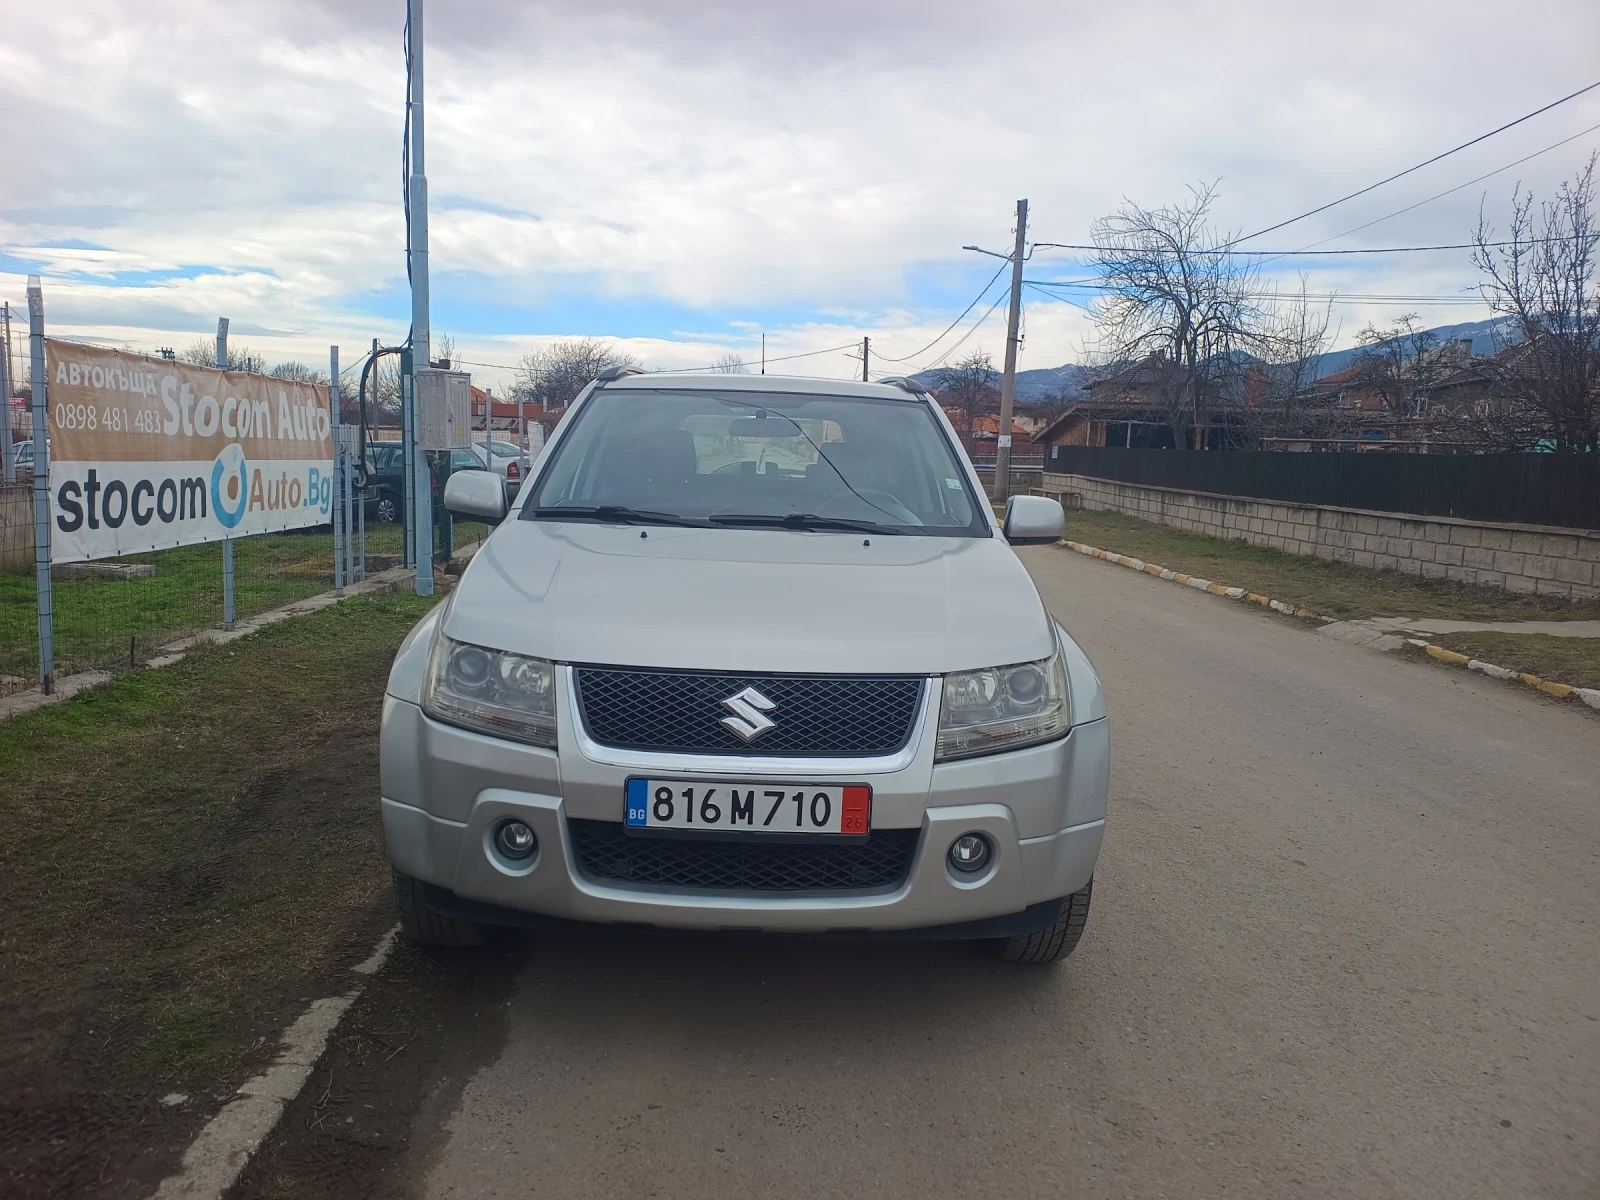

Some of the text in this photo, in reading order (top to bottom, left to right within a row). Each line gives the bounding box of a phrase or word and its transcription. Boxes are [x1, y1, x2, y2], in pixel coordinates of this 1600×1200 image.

[56, 361, 157, 398] АВТОКЪЩА
[55, 402, 161, 433] 0898 481 483
[161, 374, 330, 441] Stocom Auto
[56, 468, 207, 532] stocom
[629, 808, 645, 820] BG
[846, 815, 862, 828] 26
